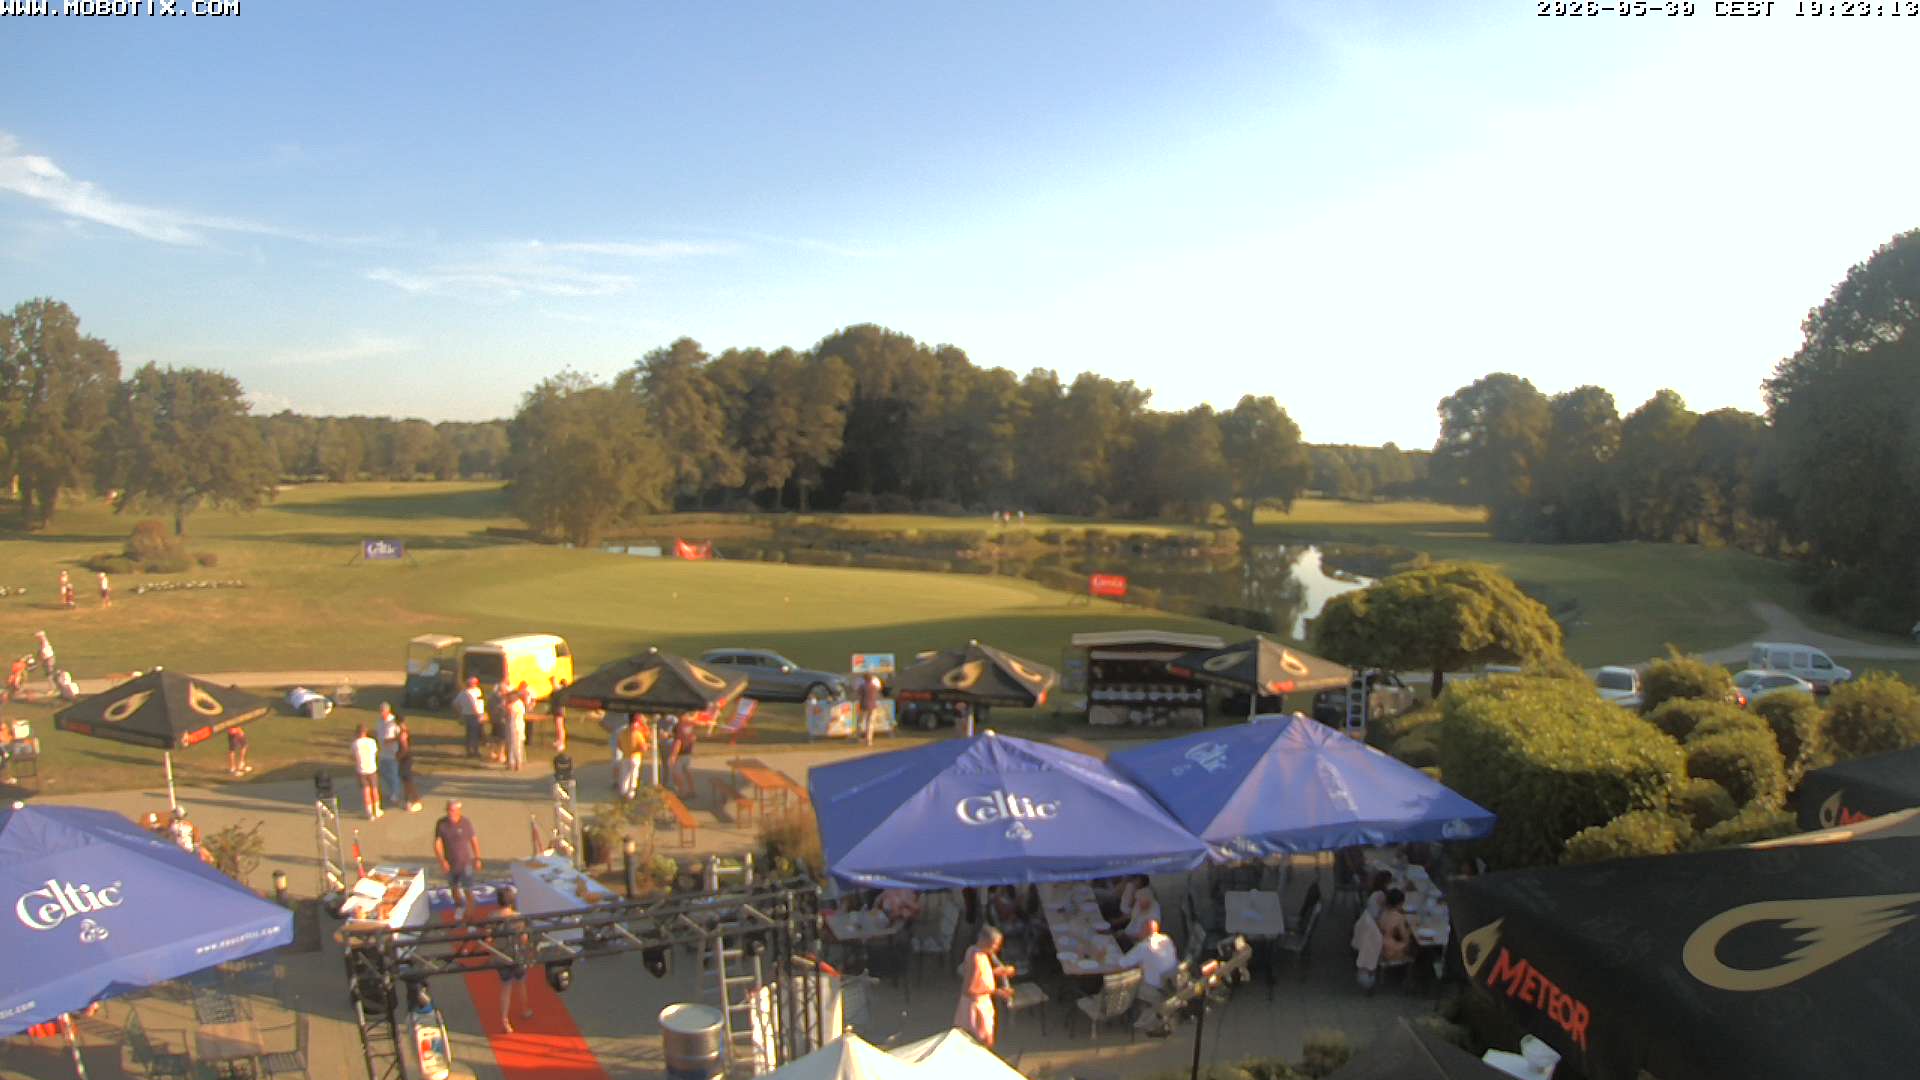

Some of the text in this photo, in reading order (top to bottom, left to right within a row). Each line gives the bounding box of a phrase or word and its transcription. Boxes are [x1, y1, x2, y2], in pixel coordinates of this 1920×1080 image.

[956, 789, 1058, 825] Celtic
[16, 879, 124, 930] Celtic
[1487, 946, 1590, 1053] METEOR
